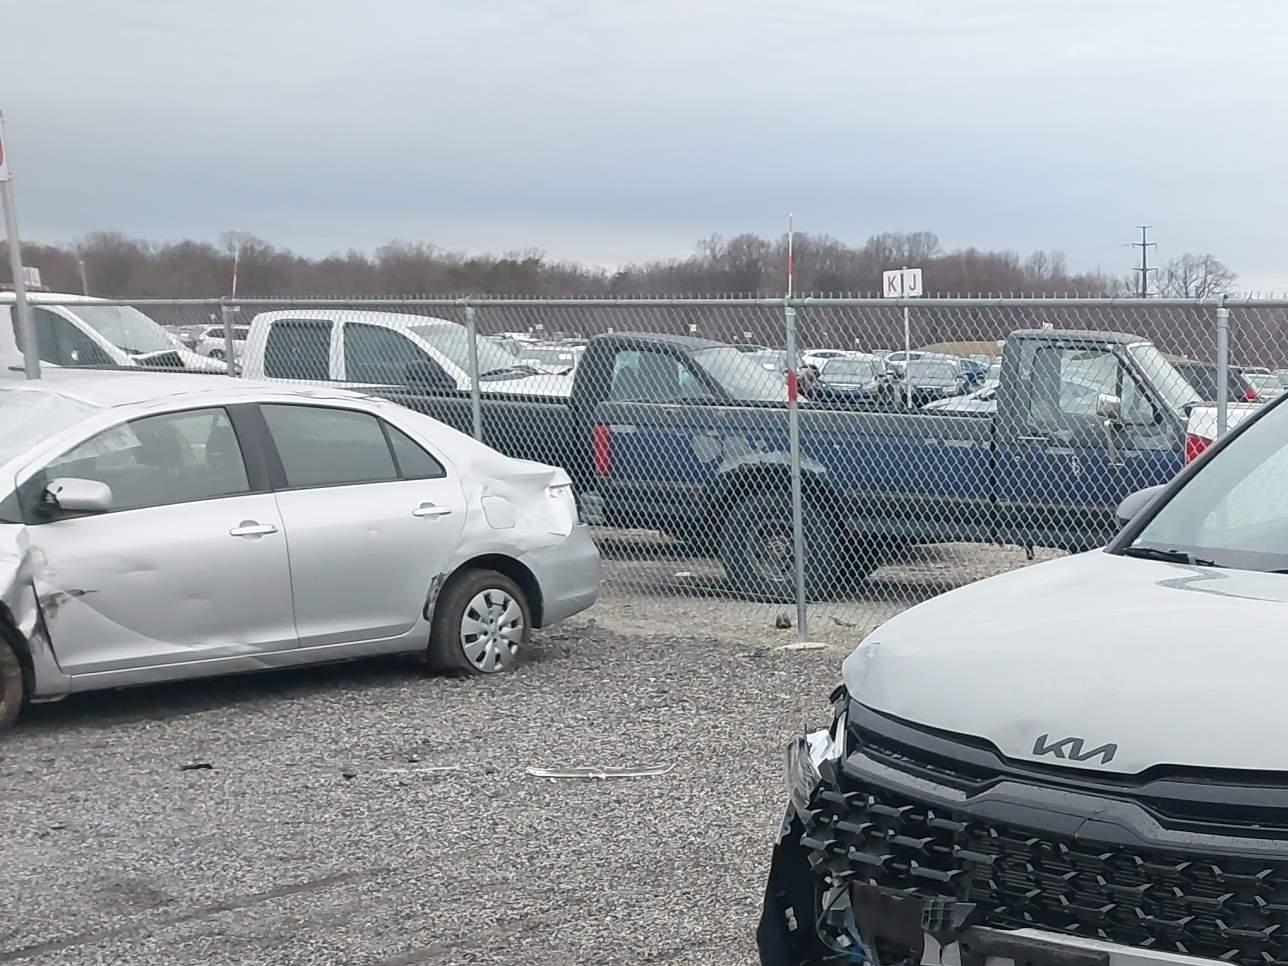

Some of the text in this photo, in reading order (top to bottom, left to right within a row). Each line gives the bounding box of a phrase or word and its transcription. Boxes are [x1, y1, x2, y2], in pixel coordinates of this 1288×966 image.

[887, 273, 917, 292] K J
[1032, 733, 1118, 765] KIA
